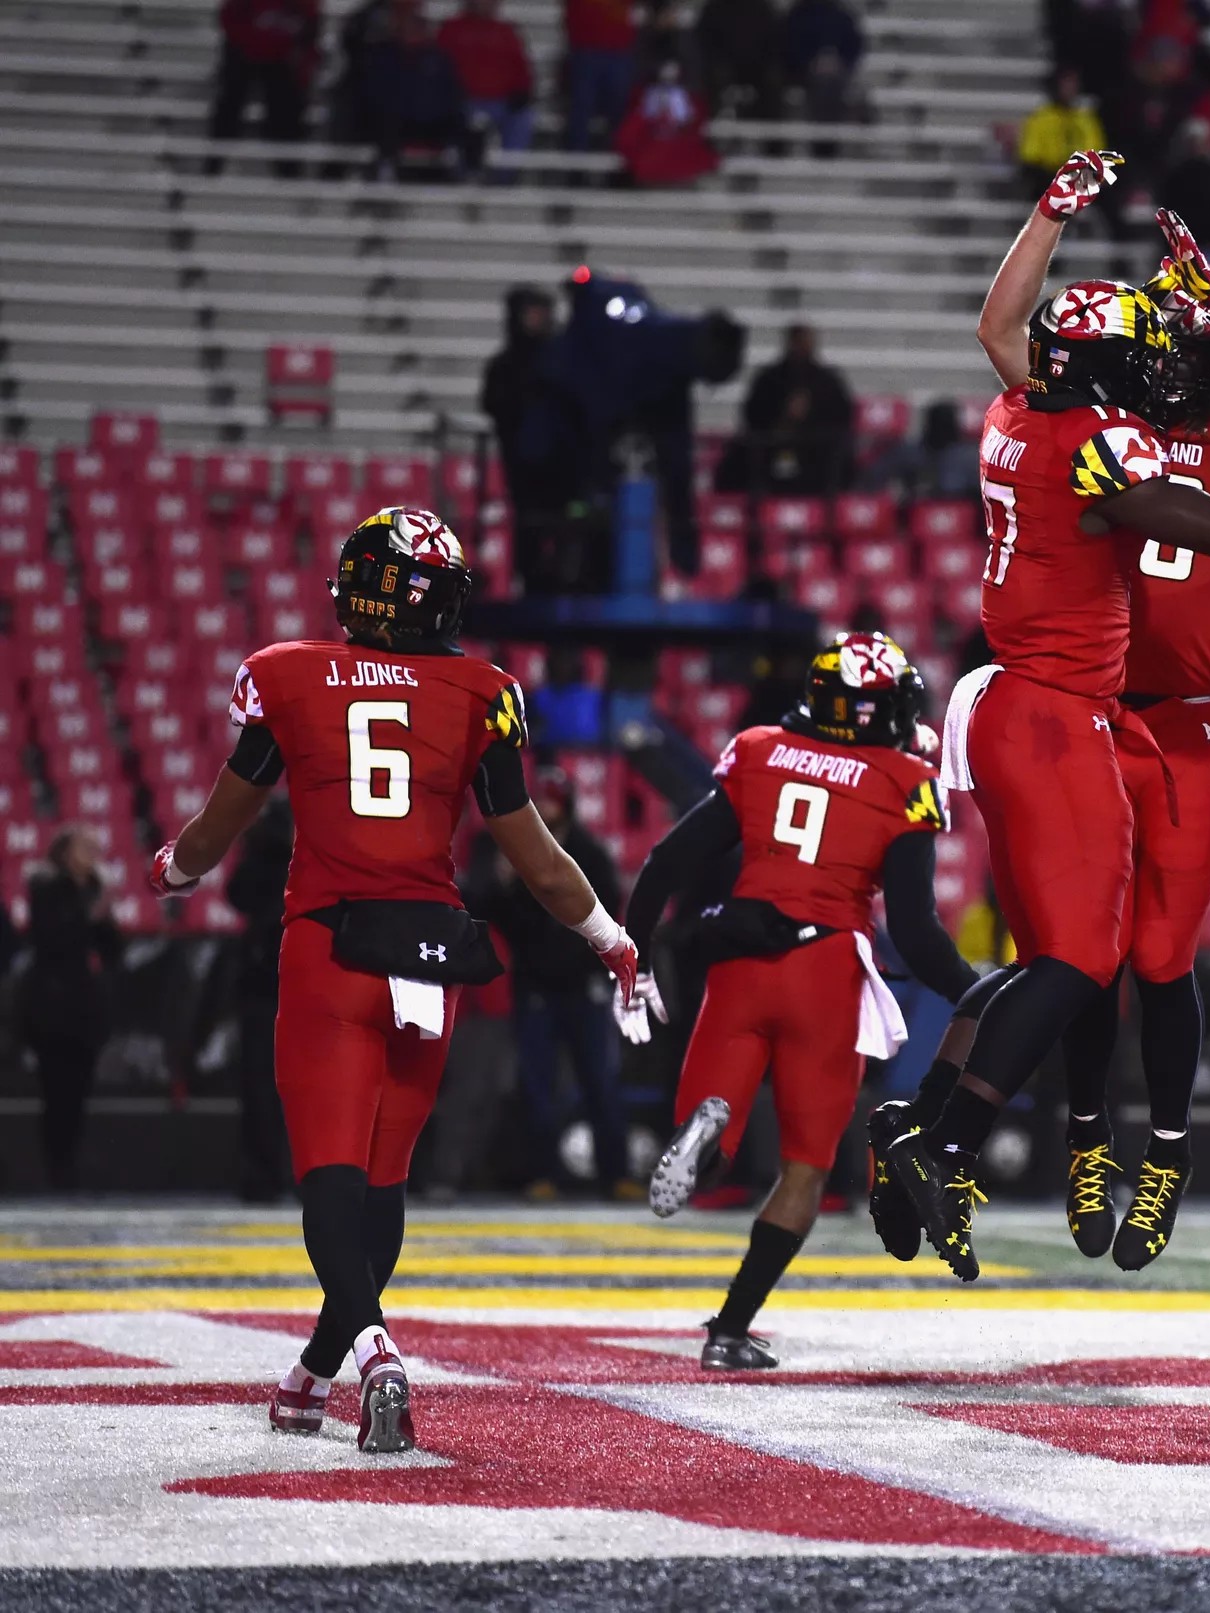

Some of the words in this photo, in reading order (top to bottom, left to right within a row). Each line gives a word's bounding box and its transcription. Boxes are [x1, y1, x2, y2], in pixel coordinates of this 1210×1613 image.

[1051, 363, 1063, 375] 79
[1169, 441, 1203, 467] AND
[381, 564, 399, 593] 6
[350, 596, 396, 619] TERPS
[408, 590, 422, 603] 79
[326, 660, 346, 687] J.
[351, 660, 419, 687] JONES
[347, 700, 411, 818] 6
[767, 744, 868, 787] DAVENPORT
[773, 782, 830, 865] 9
